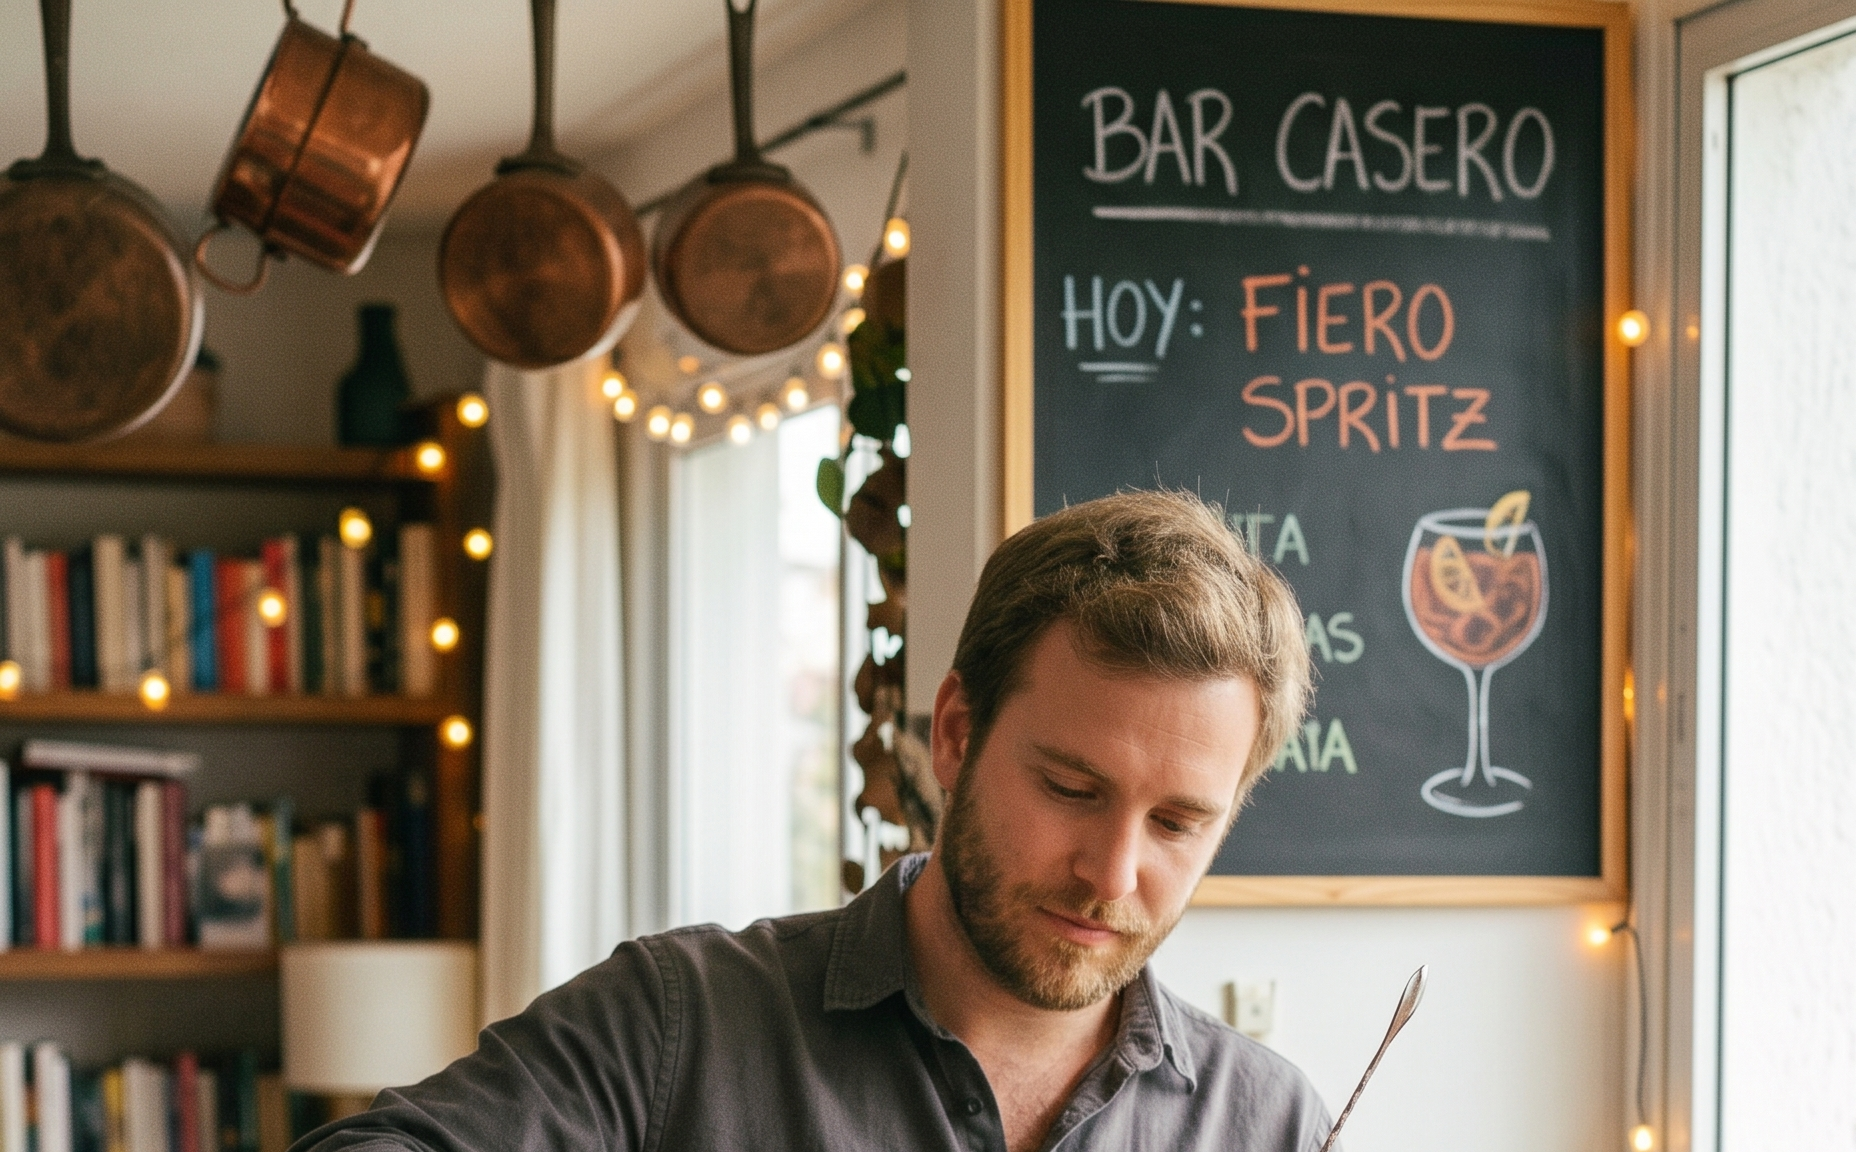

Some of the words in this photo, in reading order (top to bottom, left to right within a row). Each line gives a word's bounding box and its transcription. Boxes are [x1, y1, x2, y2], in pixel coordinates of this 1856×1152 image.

[1081, 86, 1238, 195] BAR
[1276, 91, 1556, 201] CASERO
[1060, 274, 1204, 358] HOY:
[1305, 611, 1366, 664] AS
